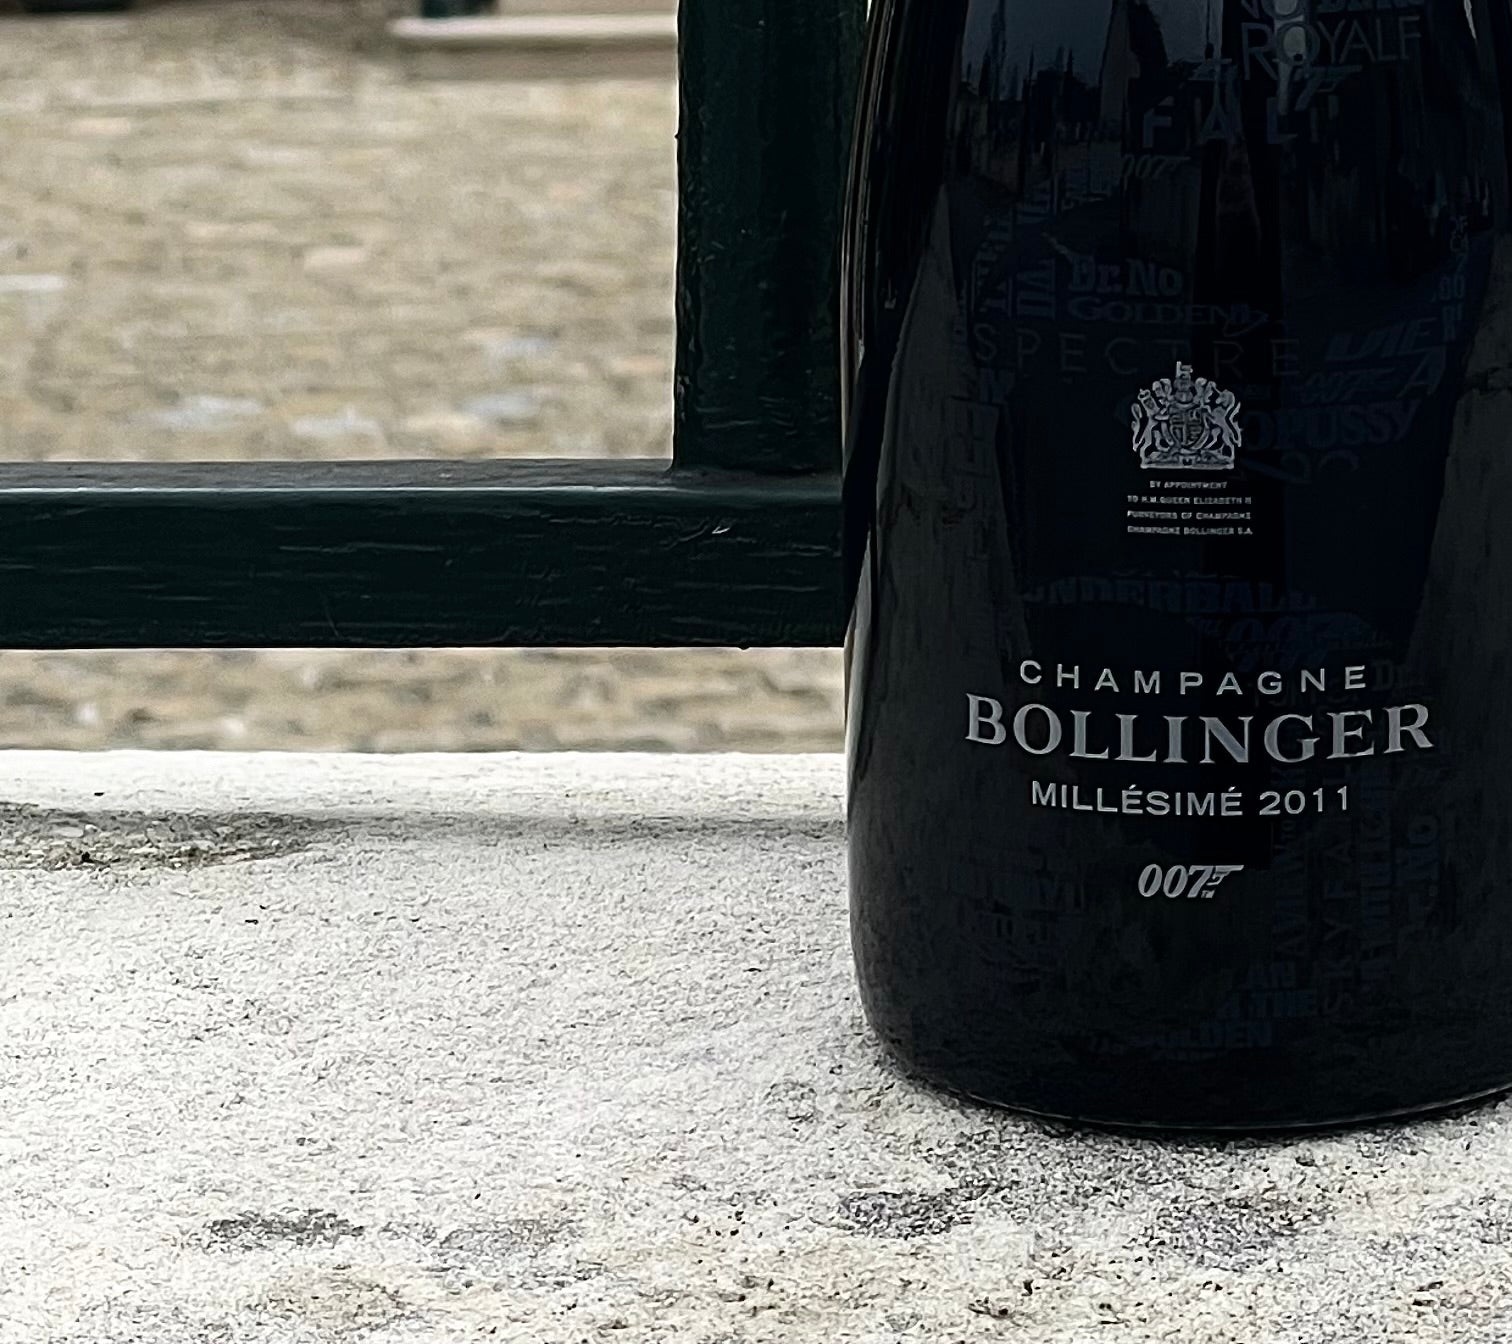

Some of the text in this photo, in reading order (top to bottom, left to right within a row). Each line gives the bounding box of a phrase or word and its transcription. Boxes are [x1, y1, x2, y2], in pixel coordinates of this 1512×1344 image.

[1164, 481, 1228, 489] APPOINTMENT
[1193, 497, 1242, 505] ELIZABETH
[1183, 526, 1235, 535] BOLLINGER
[1020, 659, 1366, 695] CHAMPAGNE
[964, 693, 1434, 764] BOLLINGER
[1032, 780, 1348, 816] MILLÉSIMÉ 2011
